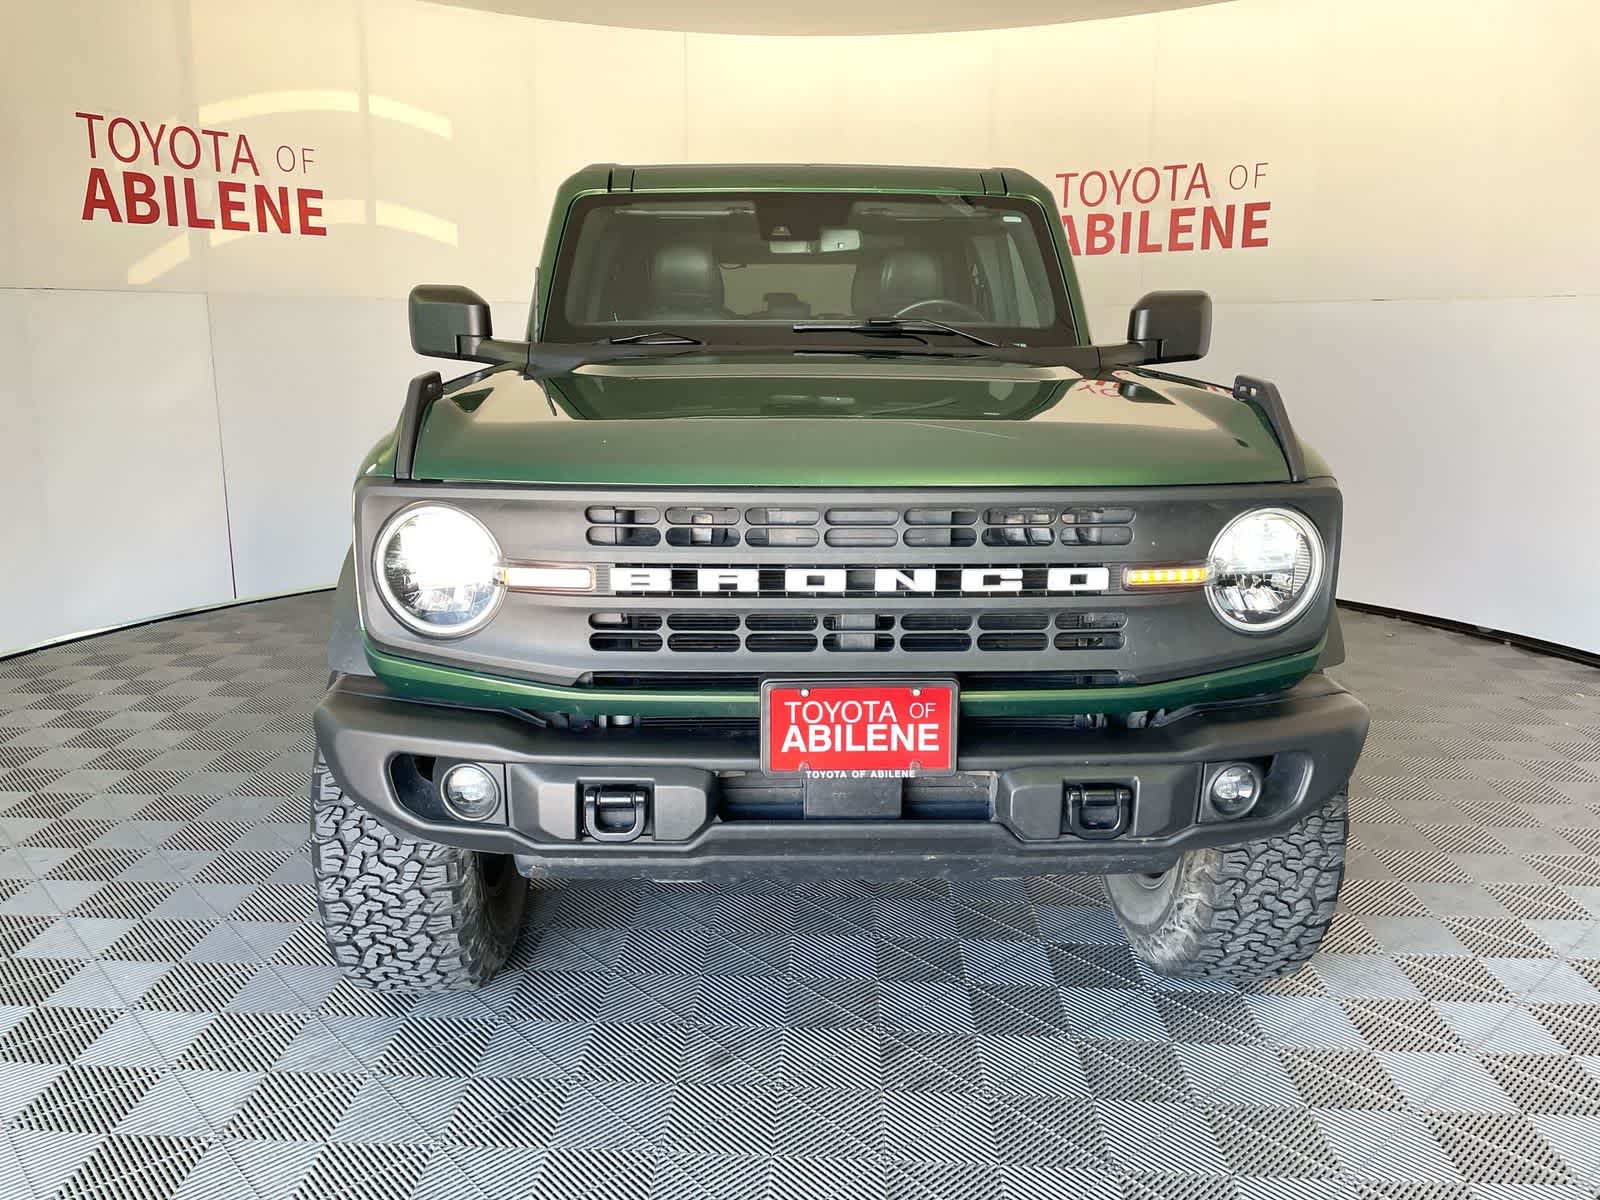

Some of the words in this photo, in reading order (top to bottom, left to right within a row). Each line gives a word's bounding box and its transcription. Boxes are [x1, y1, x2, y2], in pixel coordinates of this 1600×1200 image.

[75, 112, 260, 176] TOYOTA
[276, 145, 315, 174] OF
[81, 167, 327, 236] ABILENE
[1055, 162, 1211, 208] TOYOTA
[1229, 162, 1269, 190] OF
[1062, 201, 1271, 256] ABILENE
[609, 567, 1110, 592] BRONCO
[784, 700, 897, 723] TOYOTA
[909, 702, 936, 719] OF
[780, 723, 939, 752] ABILENE
[806, 770, 847, 779] TOYOTA
[851, 770, 865, 778] OF
[870, 770, 916, 778] ABILENE
